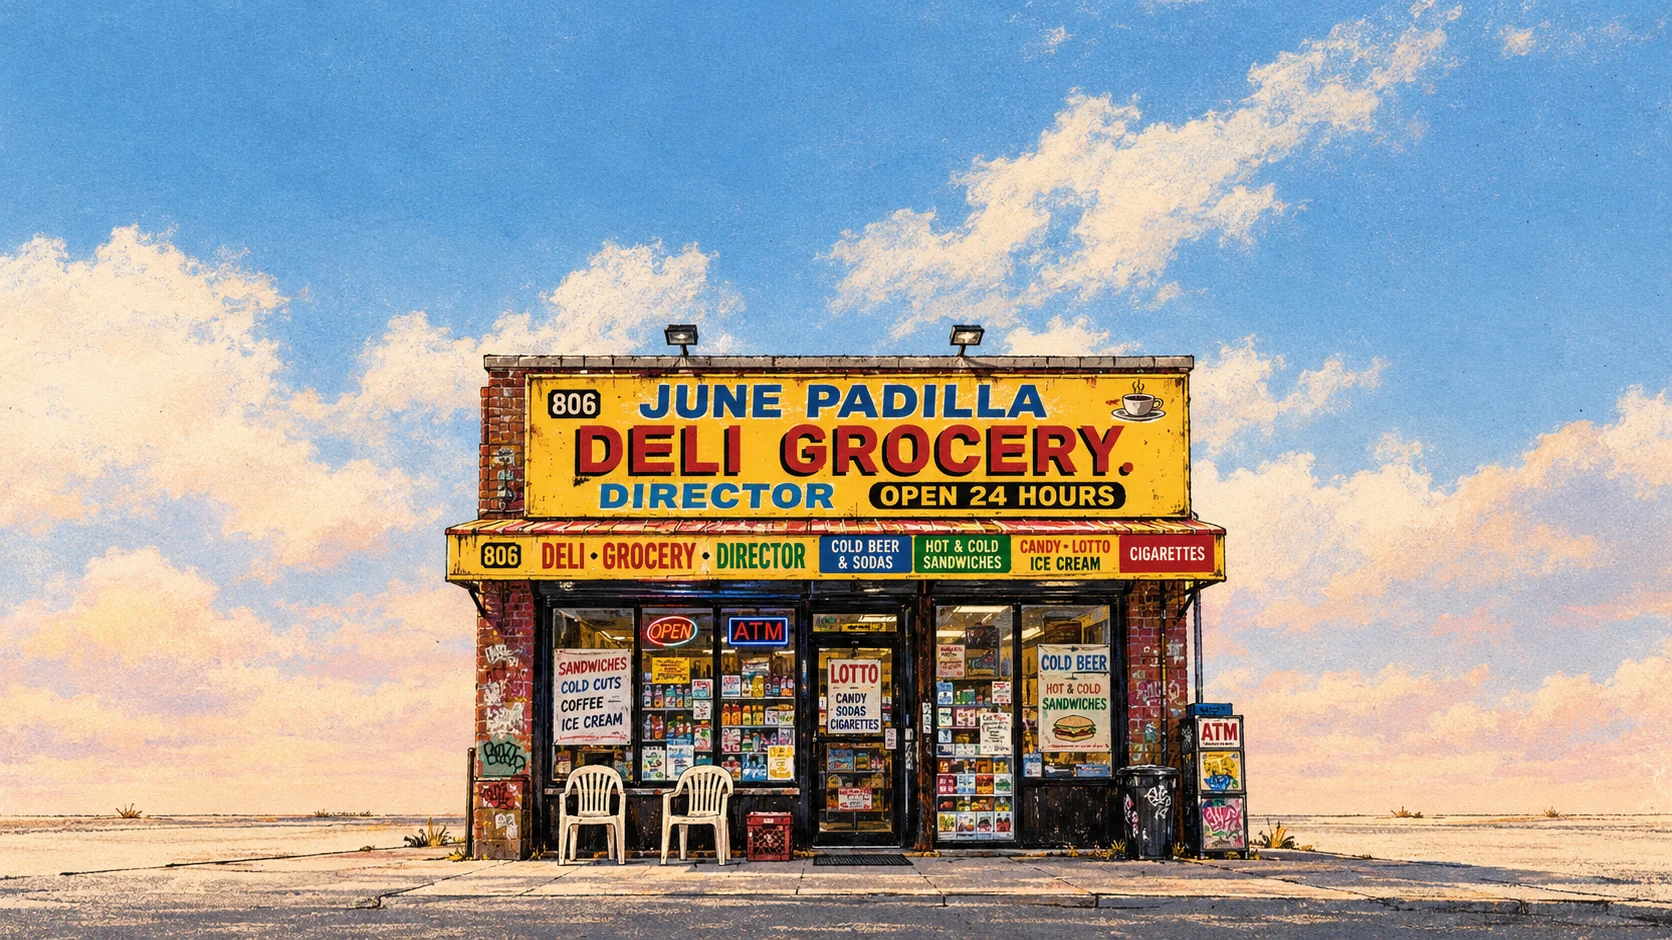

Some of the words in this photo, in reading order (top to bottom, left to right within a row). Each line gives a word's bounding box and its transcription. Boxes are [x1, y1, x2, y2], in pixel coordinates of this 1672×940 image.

[552, 392, 597, 415] 806
[640, 384, 782, 418] JUNE
[807, 384, 1047, 418] PADILLA
[575, 425, 741, 476] DELI
[600, 483, 834, 509] DIRECTOR
[880, 486, 957, 506] OPEN
[969, 486, 1007, 506] 24
[1018, 486, 1114, 506] HOURS
[831, 540, 864, 553] COLD
[869, 540, 900, 553] BEER
[926, 540, 949, 553] HOT
[954, 540, 963, 553] &
[968, 540, 999, 553] COLD
[1020, 540, 1063, 554] CANDY
[1072, 540, 1111, 553] LOTTO
[1129, 546, 1206, 562] CIGARETTES
[483, 546, 519, 566] 806
[542, 542, 585, 569] DELI
[602, 542, 697, 569] GROCERY
[716, 542, 806, 569] DIRECTOR
[838, 556, 848, 569] &
[852, 556, 893, 569] SODAS
[923, 556, 1002, 569] SANDWICHES
[1030, 557, 1049, 571] ICE
[1055, 557, 1101, 571] CREAM
[650, 623, 692, 639] OPEN
[734, 621, 782, 640] ATM
[558, 657, 627, 676] SANDWICHES
[1041, 655, 1072, 671] COLD
[1078, 654, 1107, 670] BEER
[830, 664, 878, 684] LOTTO
[561, 679, 589, 694] COLD
[593, 676, 621, 692] CUTS
[1046, 683, 1064, 695] HOT
[1066, 683, 1074, 695] &
[1077, 683, 1101, 695] COLD
[561, 696, 604, 712] COFFEE
[836, 693, 867, 705] CANDY
[1042, 698, 1107, 711] SANDWICHES
[836, 706, 866, 717] SODAS
[561, 717, 579, 731] ICE
[583, 712, 623, 728] CREAM
[830, 718, 879, 730] CIGARETTES
[1201, 723, 1238, 741] ATM
